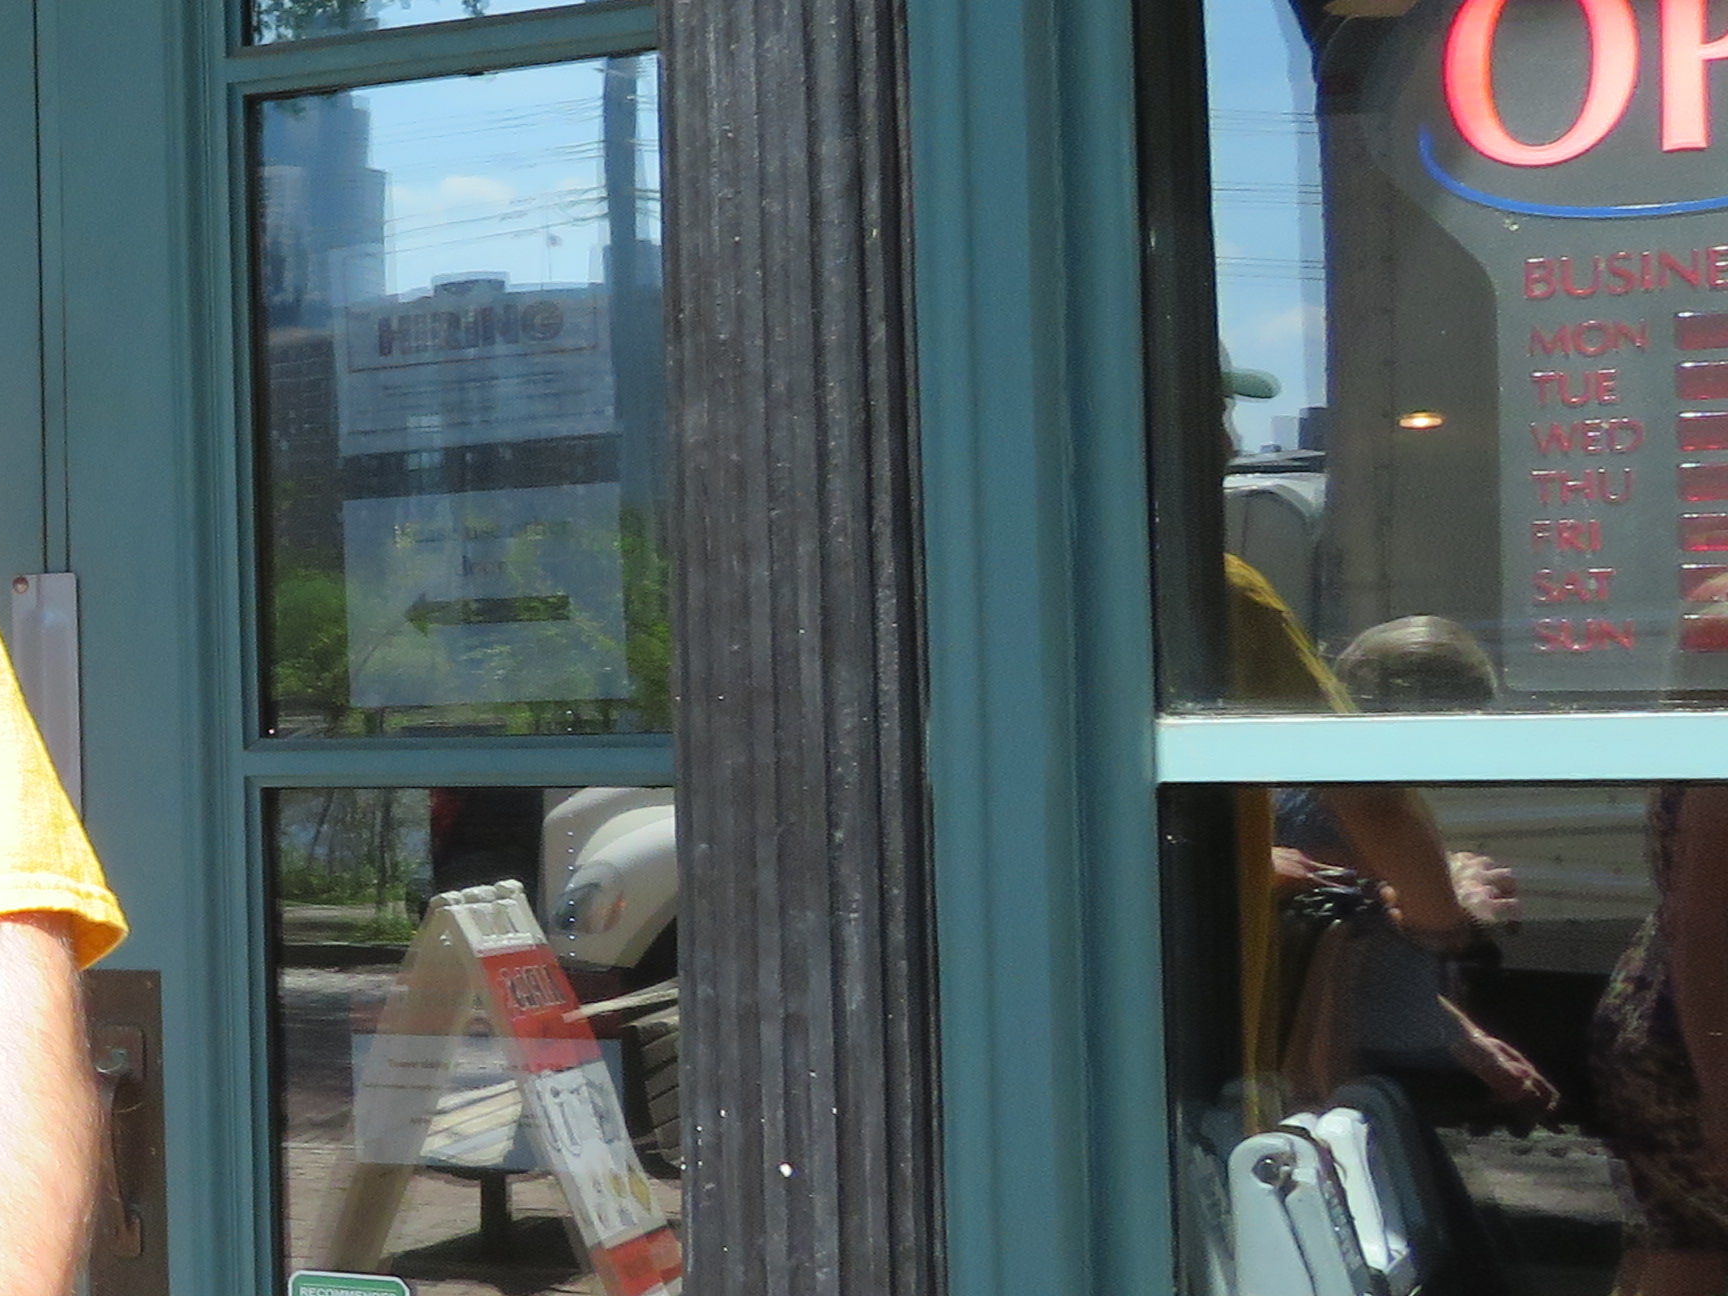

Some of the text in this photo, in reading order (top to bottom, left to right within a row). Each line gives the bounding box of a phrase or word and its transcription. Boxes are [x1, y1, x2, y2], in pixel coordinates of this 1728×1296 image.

[1528, 319, 1649, 356] MON
[1530, 368, 1618, 407] TUE
[1530, 419, 1644, 454] WED
[1532, 467, 1634, 504] THU
[1531, 519, 1602, 551] FRI
[1532, 567, 1617, 602] SAT
[1534, 618, 1635, 651] SUN
